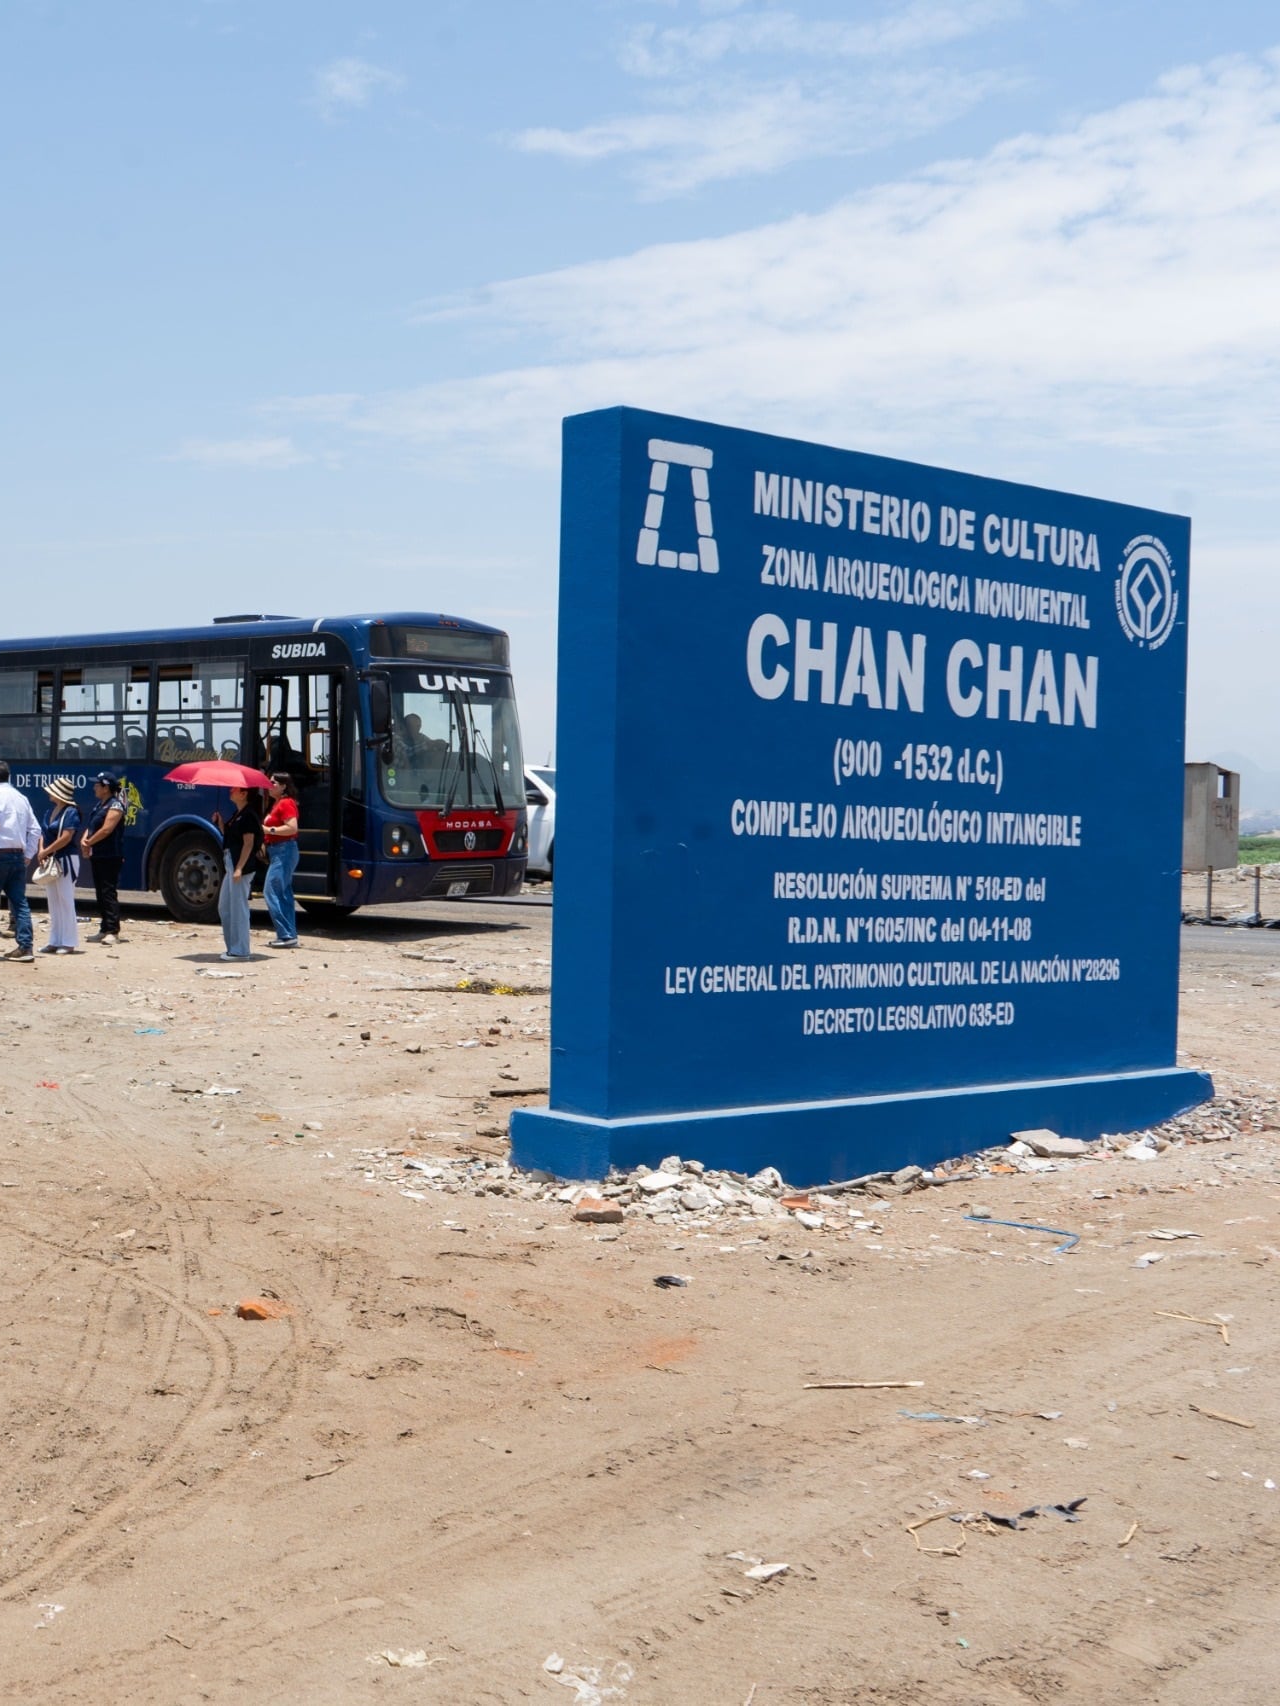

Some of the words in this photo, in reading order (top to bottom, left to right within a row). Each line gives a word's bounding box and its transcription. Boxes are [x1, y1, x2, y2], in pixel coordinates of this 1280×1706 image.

[755, 471, 931, 543] MINISTERIO
[940, 506, 976, 551] DE
[983, 514, 1100, 572] CULTURA
[761, 545, 819, 591] ZONA
[824, 556, 971, 613] ARQUEOLOGICA
[975, 578, 1090, 630] MONUMENTAL
[271, 642, 326, 659] SUBIDA
[418, 674, 490, 694] UNT
[747, 614, 926, 713] CHAN
[947, 639, 1099, 729] CHAN
[17, 774, 32, 788] DE
[33, 774, 87, 789] TRULO
[834, 738, 882, 786] (900
[894, 743, 953, 781] -1532
[957, 748, 1003, 795] d.C.)
[446, 820, 492, 829] MODASA
[731, 798, 837, 838] COMPLEJO
[842, 801, 982, 844] ARQUEOLÓGICO
[986, 811, 1082, 847] INTANGIBLE
[774, 867, 877, 900] RESOLUCIÓN
[881, 874, 953, 901] SUPREMA
[976, 876, 1023, 902] 518-ED
[1025, 877, 1046, 902] del
[788, 917, 840, 944] R.D.N.
[846, 916, 936, 943] N°1605/INC
[941, 917, 965, 942] del
[969, 916, 1032, 942] 04-11-08
[665, 966, 697, 995] LEY
[700, 965, 777, 994] GENERAL
[781, 964, 811, 991] DEL
[814, 962, 904, 989] PATRIMONIO
[907, 961, 978, 987] CULTURAL
[981, 960, 1000, 985] DE
[1002, 960, 1019, 984] LA
[1021, 953, 1070, 983] NACIÓN
[804, 1007, 875, 1035] DECRETO
[878, 1003, 966, 1032] LEGISLATIVO
[968, 1001, 1014, 1027] 635-ED
